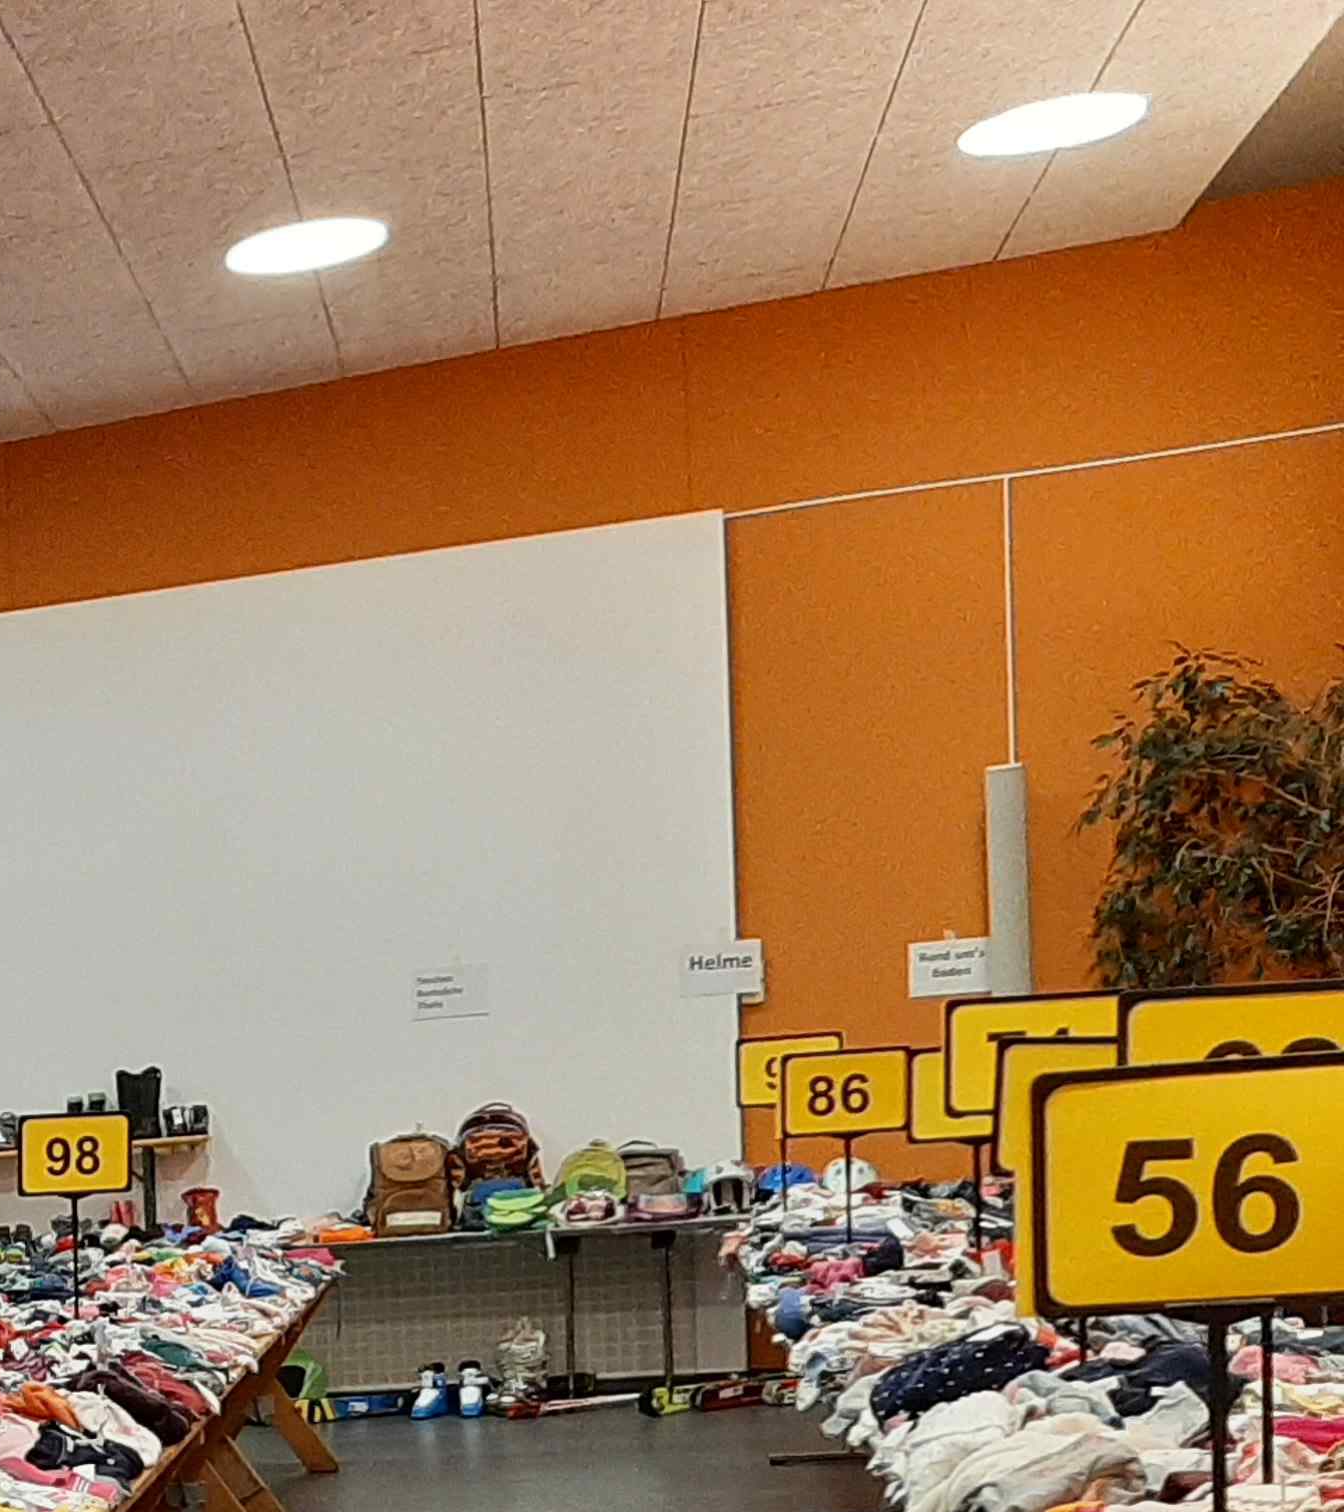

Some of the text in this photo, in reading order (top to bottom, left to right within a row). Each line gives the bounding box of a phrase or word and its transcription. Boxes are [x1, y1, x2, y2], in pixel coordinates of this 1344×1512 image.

[688, 952, 753, 972] Helme
[807, 1072, 870, 1117] 86
[45, 1135, 101, 1177] 98
[1111, 1133, 1301, 1258] 56
